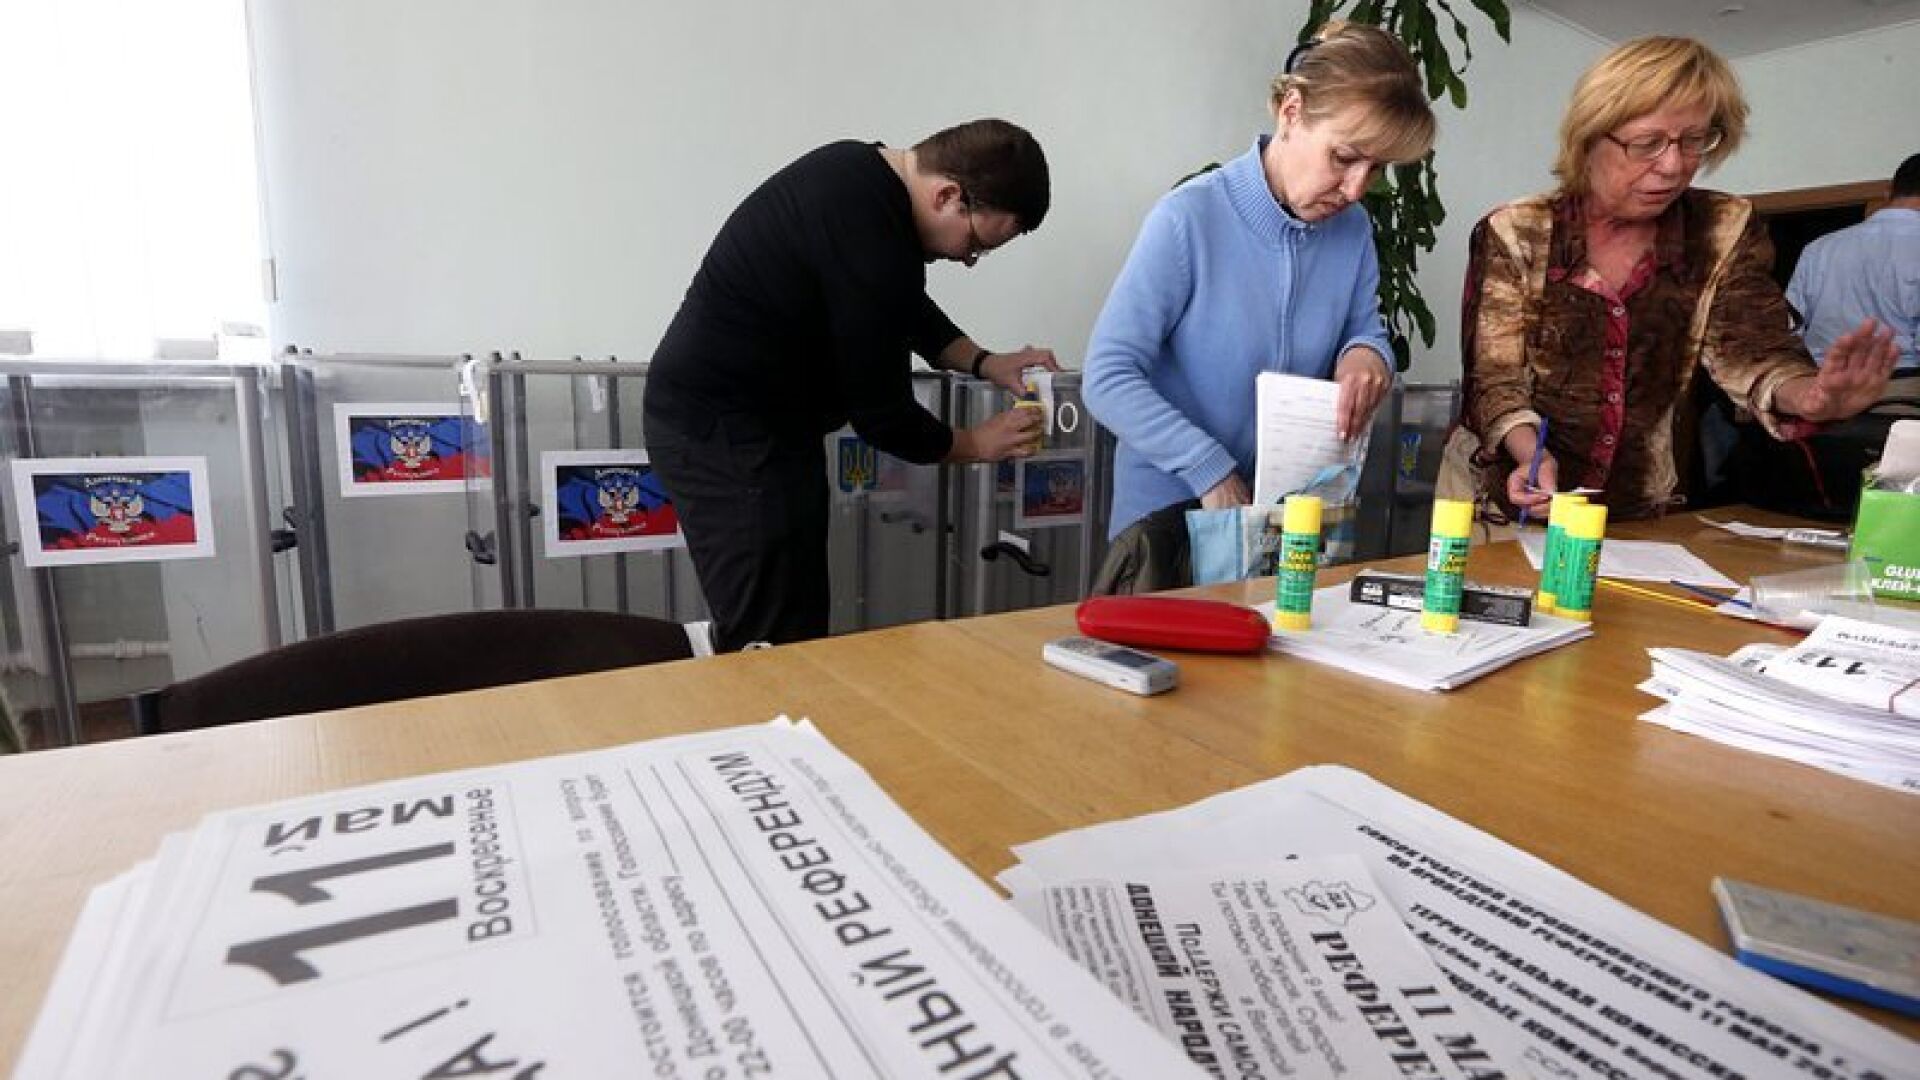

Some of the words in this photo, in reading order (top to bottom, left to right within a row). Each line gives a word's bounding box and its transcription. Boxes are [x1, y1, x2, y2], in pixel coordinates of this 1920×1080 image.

[264, 795, 456, 856] май
[466, 787, 514, 942] Воскресенье
[709, 751, 893, 948] РЕФЕРЕНДУМ
[225, 841, 459, 987] 11
[1310, 931, 1446, 1080] РЕФЕРЕ
[1521, 1019, 1632, 1080] КОМИСС
